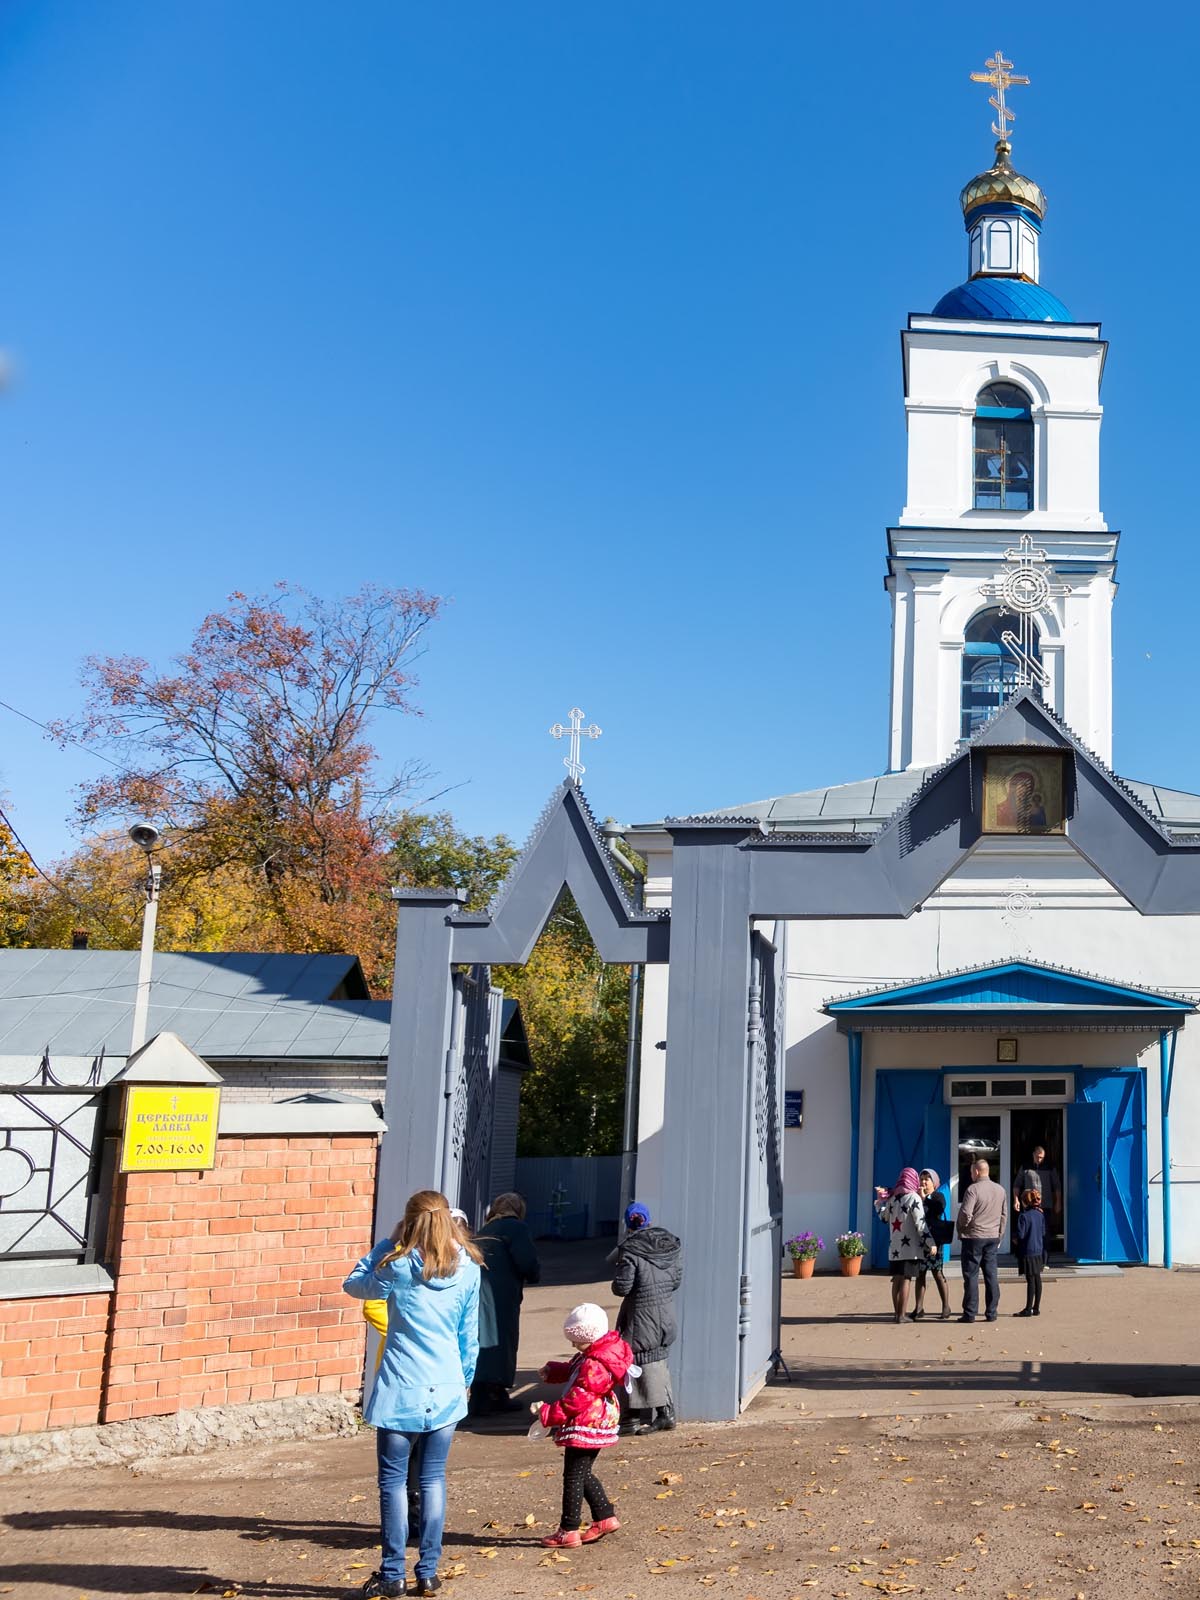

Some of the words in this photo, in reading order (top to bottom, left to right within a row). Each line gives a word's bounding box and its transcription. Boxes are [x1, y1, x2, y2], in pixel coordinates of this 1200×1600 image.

[137, 1113, 208, 1123] ЦЕРКОВНАЯ
[153, 1123, 191, 1131] ЛАВКА
[136, 1144, 204, 1155] 7.00-16.00
